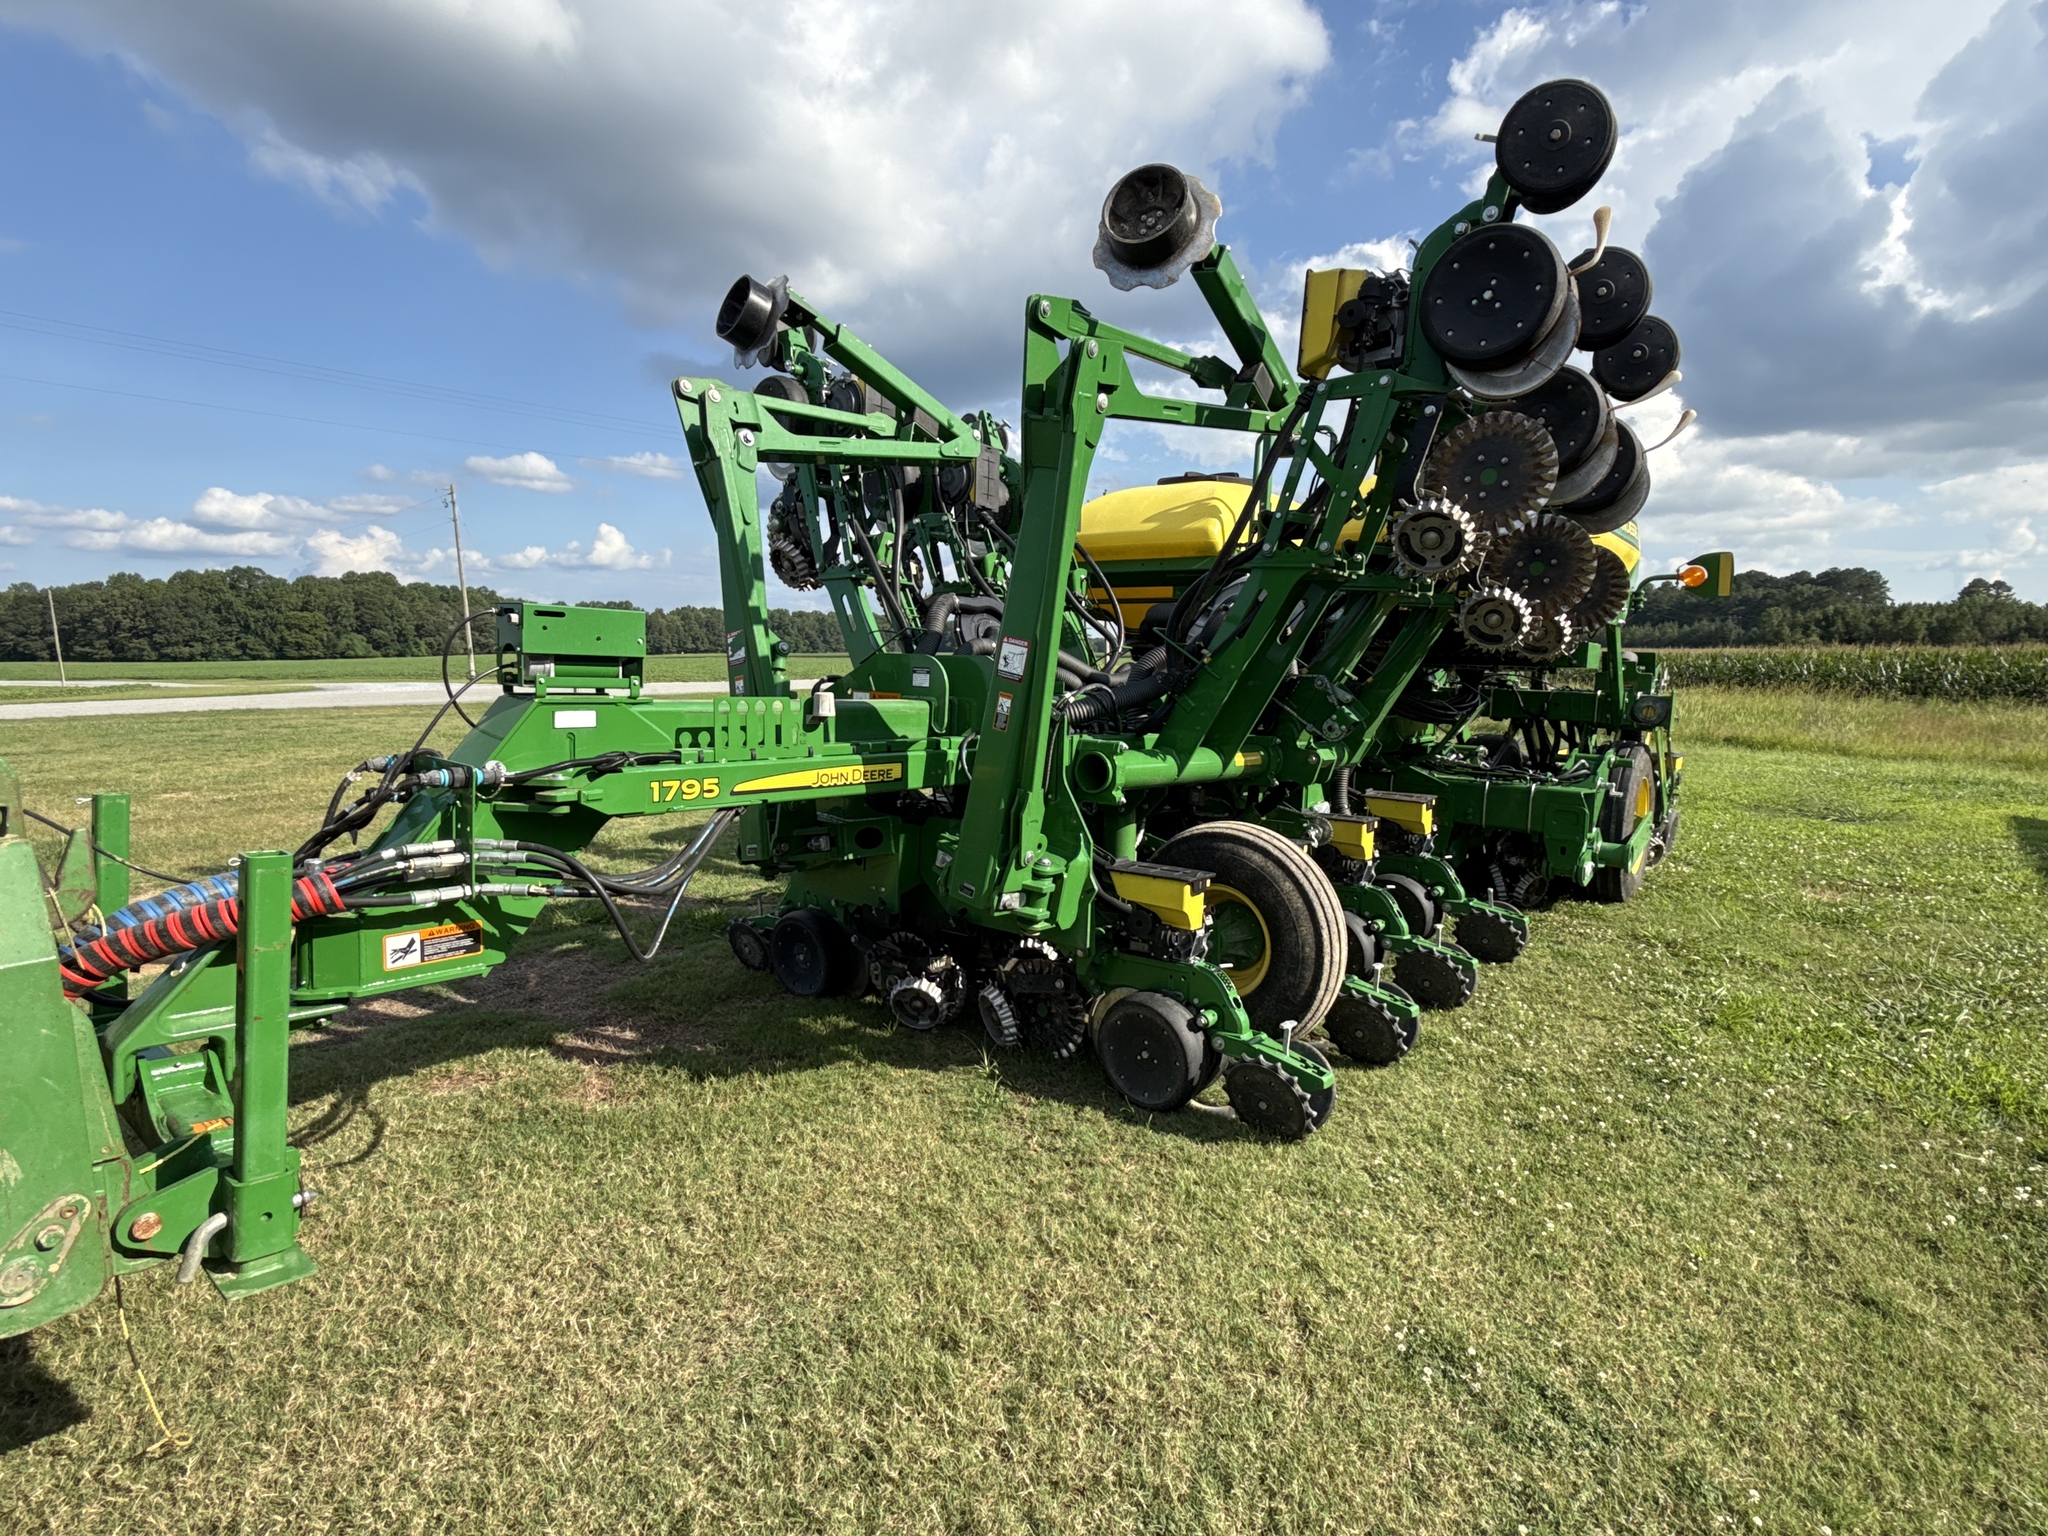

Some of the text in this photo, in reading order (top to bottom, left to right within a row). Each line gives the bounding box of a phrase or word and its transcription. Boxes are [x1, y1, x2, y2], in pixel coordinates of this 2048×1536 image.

[1008, 637, 1028, 647] DANGER
[811, 768, 893, 786] JOHN DEERE
[650, 777, 720, 803] 1795
[436, 922, 475, 934] WARNING
